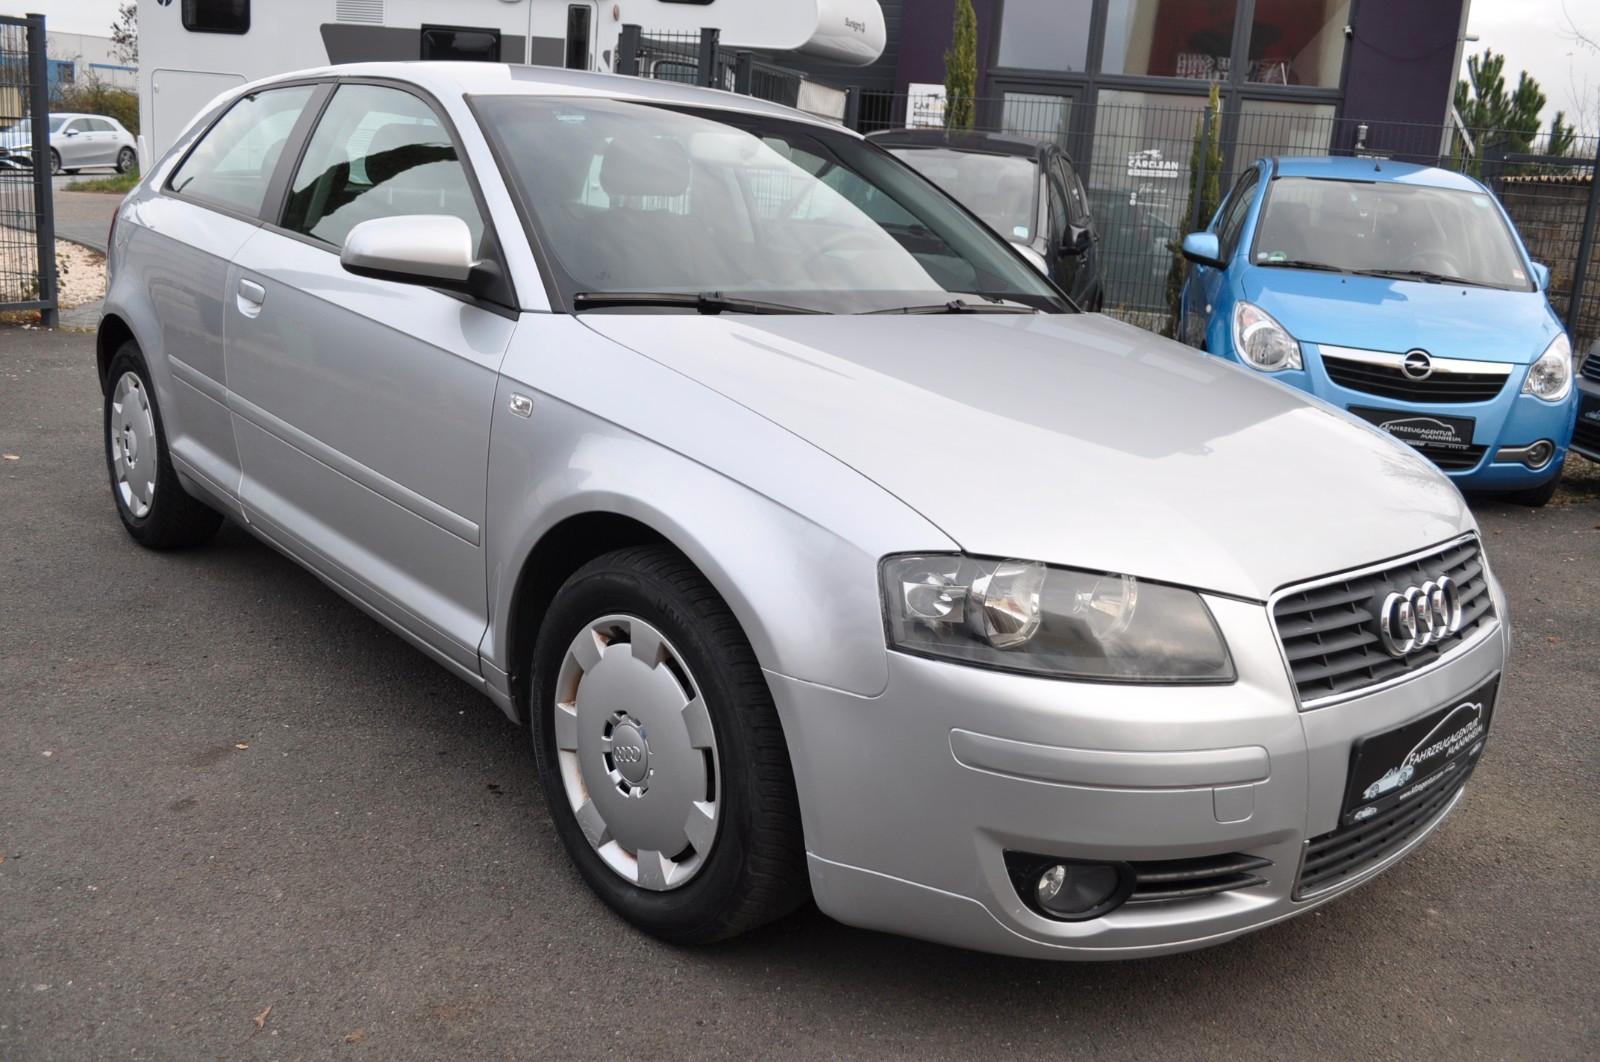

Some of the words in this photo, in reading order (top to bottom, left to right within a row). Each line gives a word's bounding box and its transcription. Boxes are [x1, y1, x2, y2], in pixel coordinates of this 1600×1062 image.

[1128, 159, 1179, 170] CARCLEAN
[1420, 434, 1462, 443] MANNHEIM
[1408, 718, 1479, 767] FAHRZEUGAGENTUR
[1446, 725, 1483, 757] MANNHEIM
